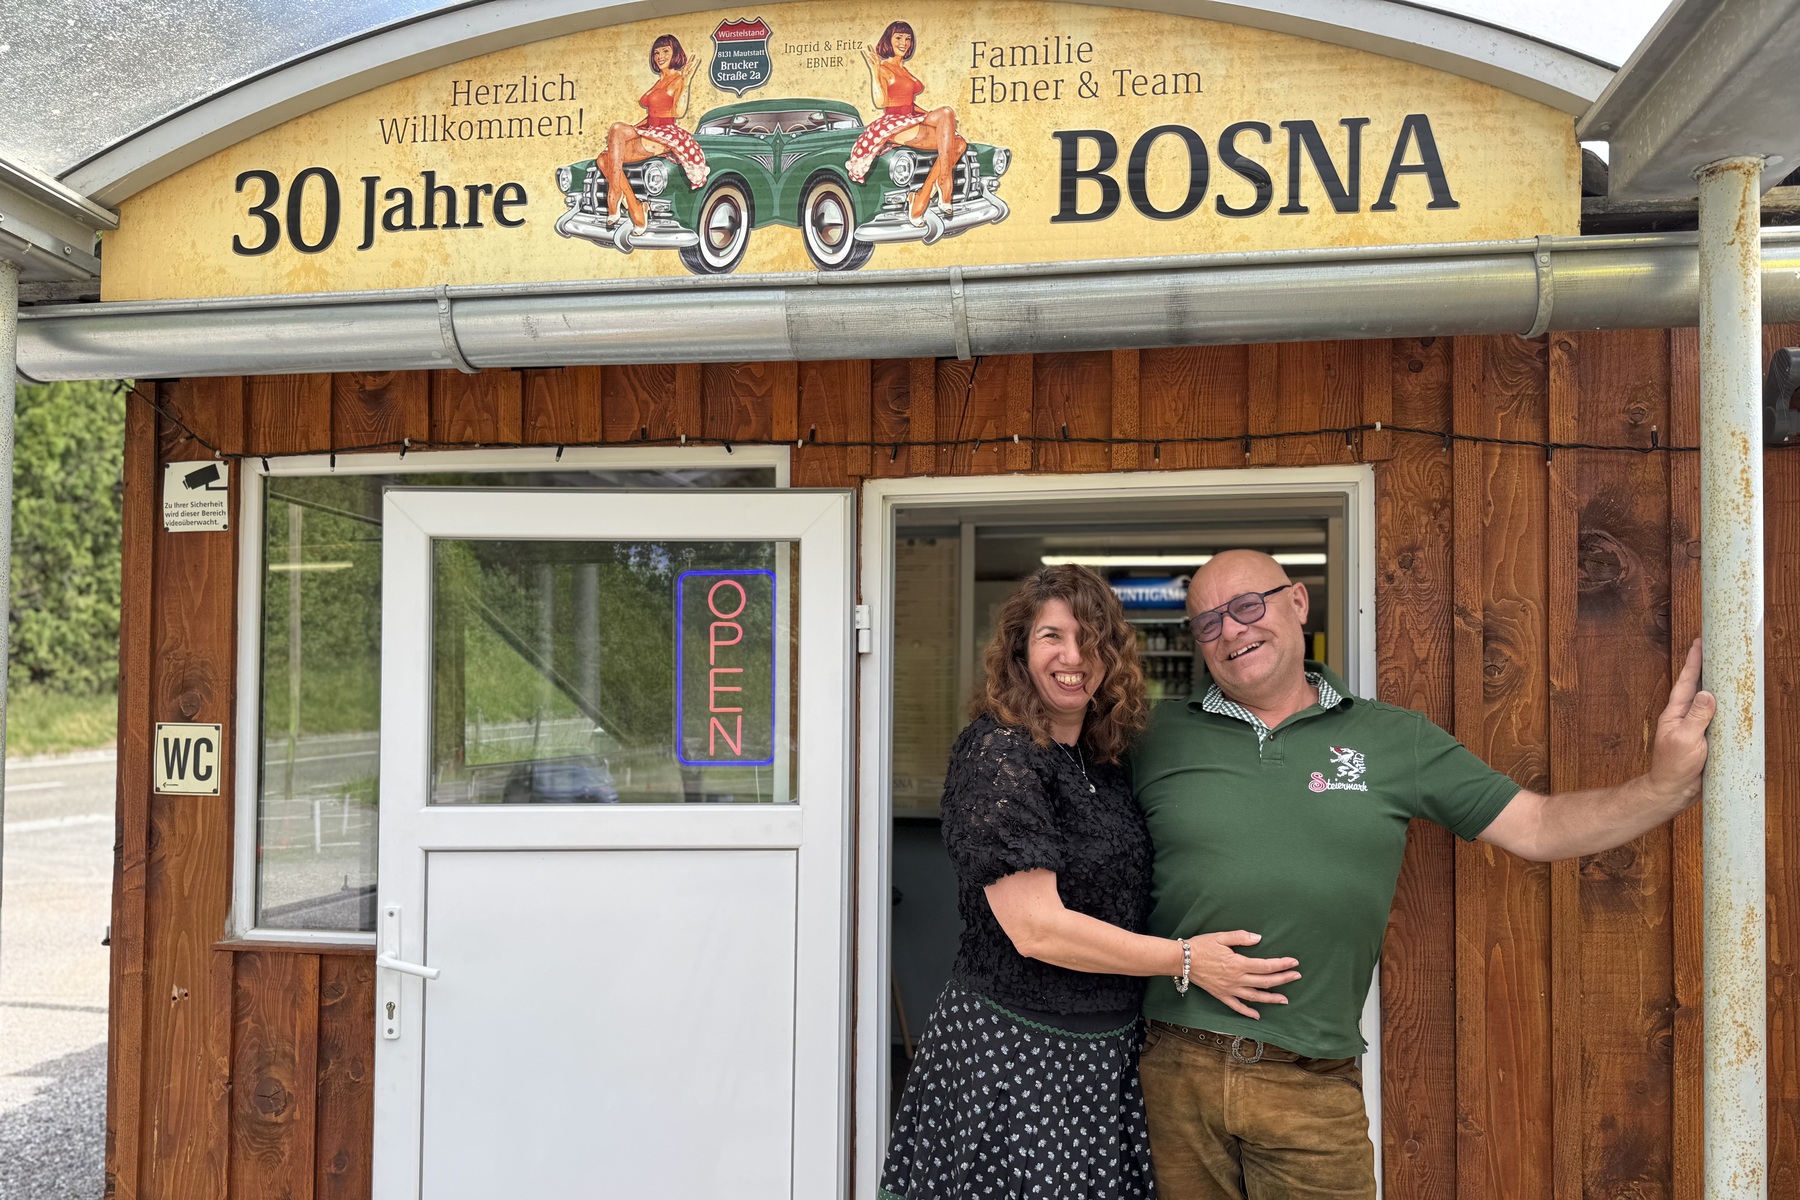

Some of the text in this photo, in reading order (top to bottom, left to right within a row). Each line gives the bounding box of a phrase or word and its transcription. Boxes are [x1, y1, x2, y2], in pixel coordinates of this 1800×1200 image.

[718, 28, 765, 38] Würstelstand
[784, 39, 863, 56] Ingrid & Fritz
[717, 49, 766, 58] 8131 Mautstatt
[720, 60, 759, 71] Brucker
[806, 56, 844, 69] EBNER
[969, 35, 1095, 70] Familie
[451, 73, 577, 108] Herzlich
[717, 70, 761, 82] Straße 2a
[969, 68, 1203, 105] Ebner & Team
[379, 108, 585, 145] Willkommen!
[1049, 113, 1461, 225] BOSNA
[232, 166, 528, 257] 30 Jahre
[707, 579, 747, 757] OPEN
[163, 737, 213, 781] WC
[1308, 772, 1369, 793] Steiermark
